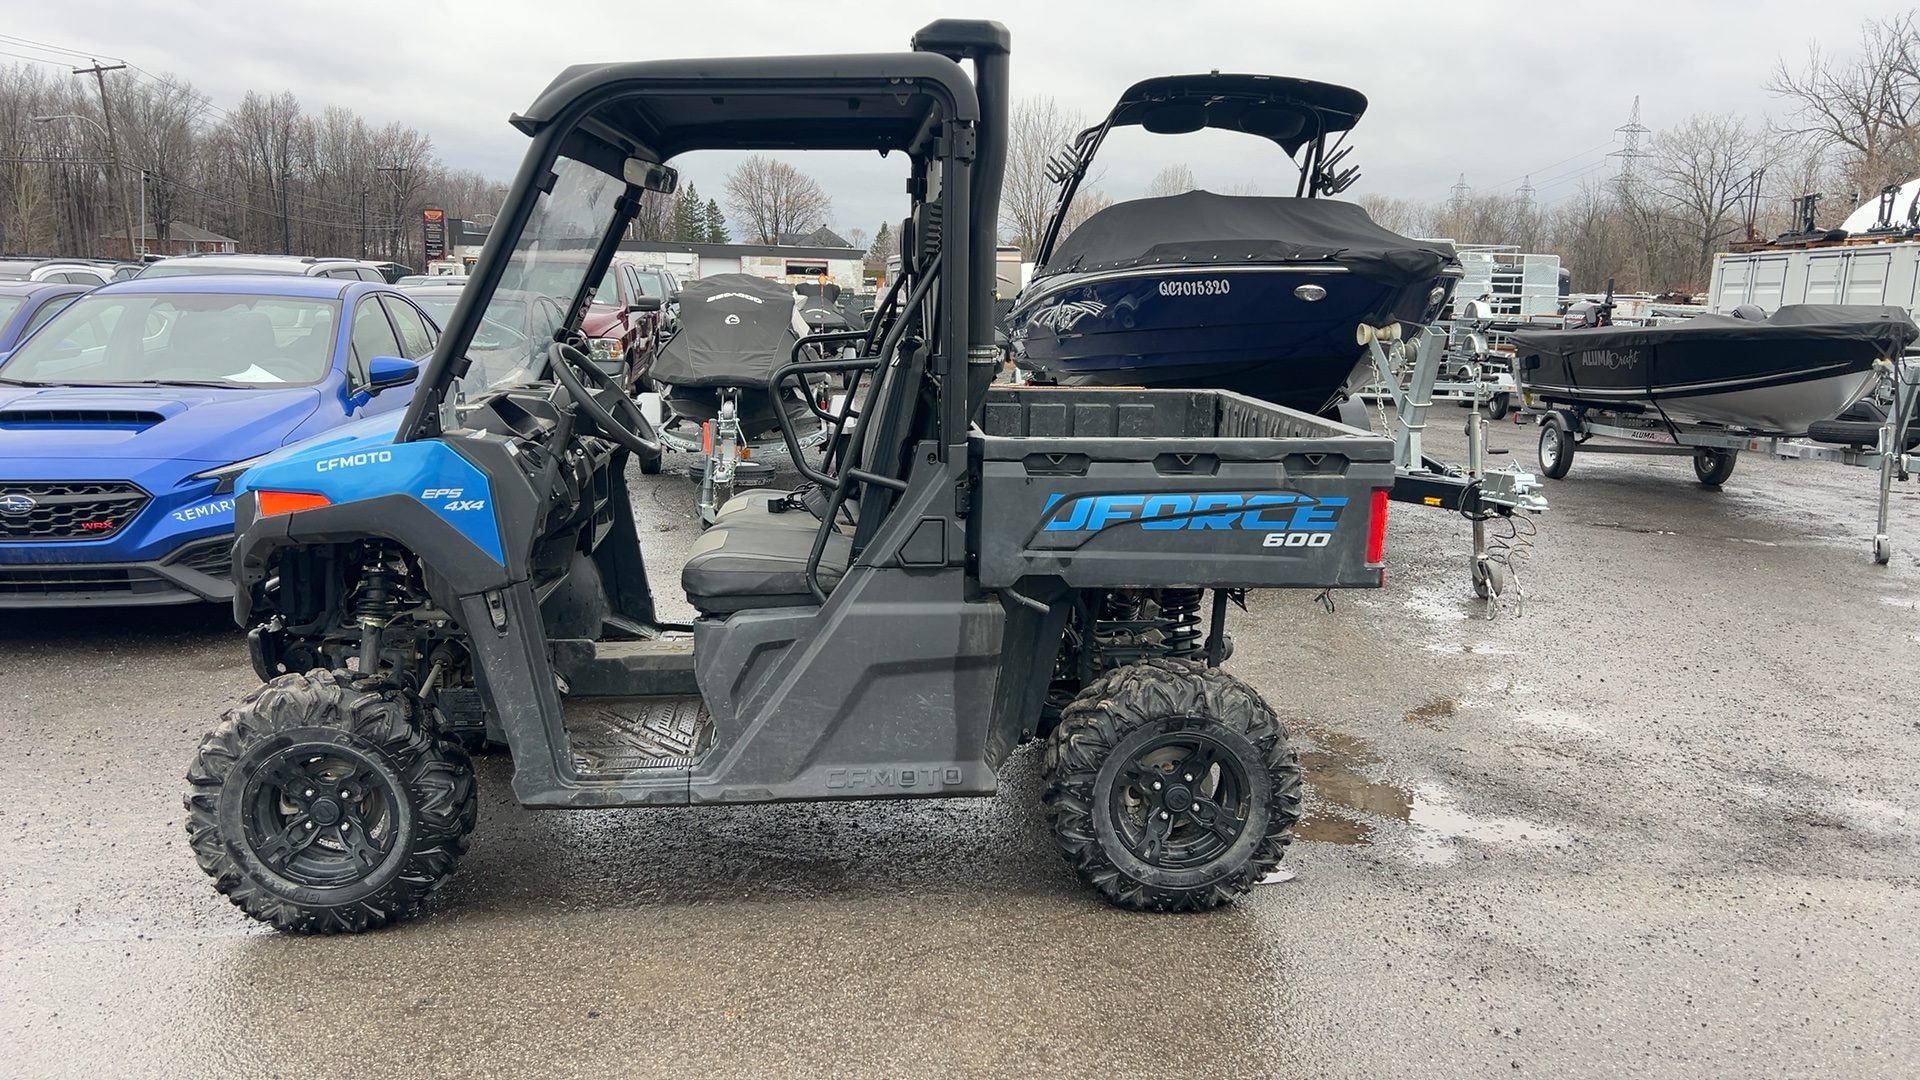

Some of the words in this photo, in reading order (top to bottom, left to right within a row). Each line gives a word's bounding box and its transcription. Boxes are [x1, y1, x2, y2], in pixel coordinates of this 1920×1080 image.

[1158, 279, 1230, 296] QC7015320
[316, 450, 392, 472] CFMOTO
[421, 488, 464, 499] EPS
[172, 498, 235, 522] REMAR
[1041, 492, 1349, 531] UFORCE
[81, 521, 114, 530] WRX
[1262, 532, 1332, 548] 600
[824, 766, 964, 789] CFMOTO
